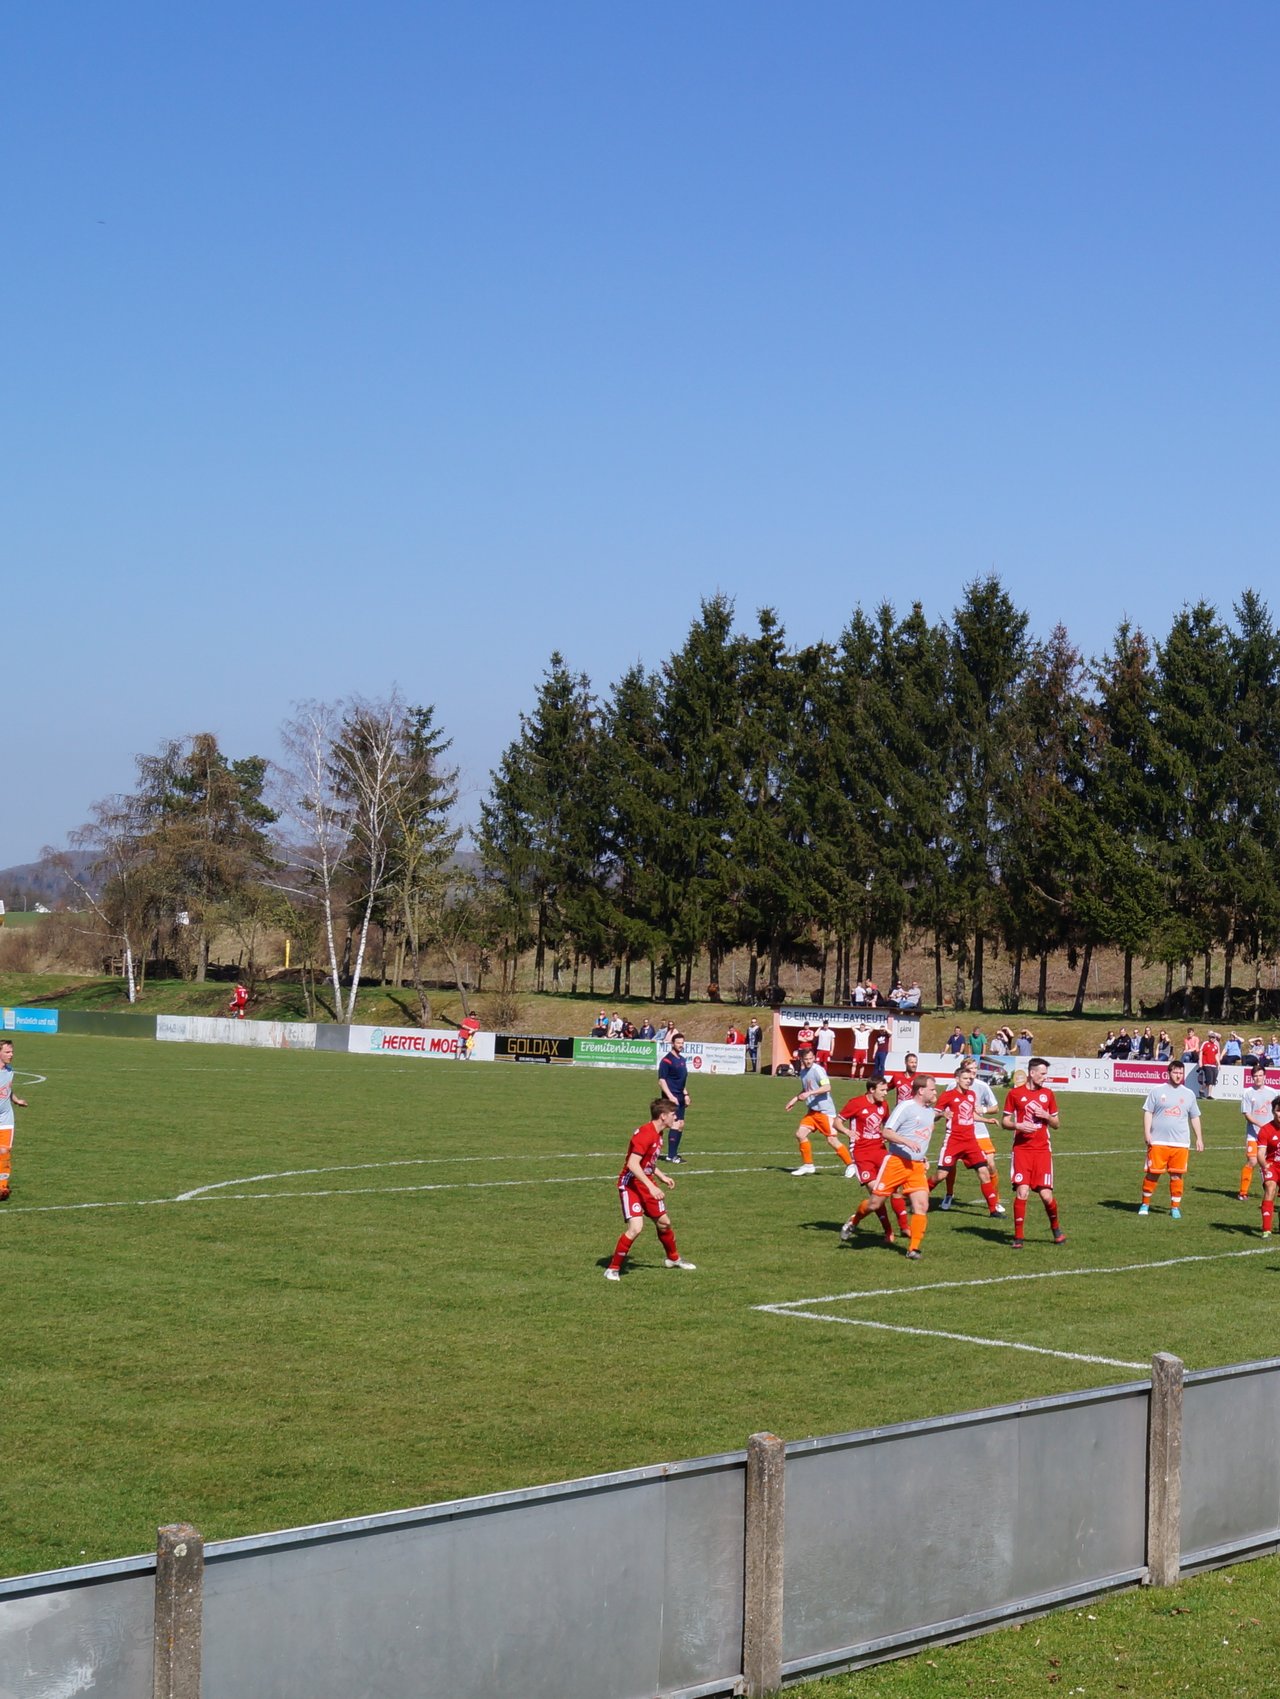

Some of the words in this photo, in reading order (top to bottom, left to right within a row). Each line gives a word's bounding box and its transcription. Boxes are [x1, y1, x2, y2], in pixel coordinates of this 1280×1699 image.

[781, 1010, 792, 1020] FC
[794, 1011, 842, 1022] EINTRACHT
[843, 1013, 889, 1024] BAYREUTH
[382, 1035, 426, 1052] HERTEL
[507, 1038, 559, 1056] GOLDAX
[580, 1041, 653, 1055] Eremitenklause
[1115, 1069, 1161, 1081] Elektrotechnik
